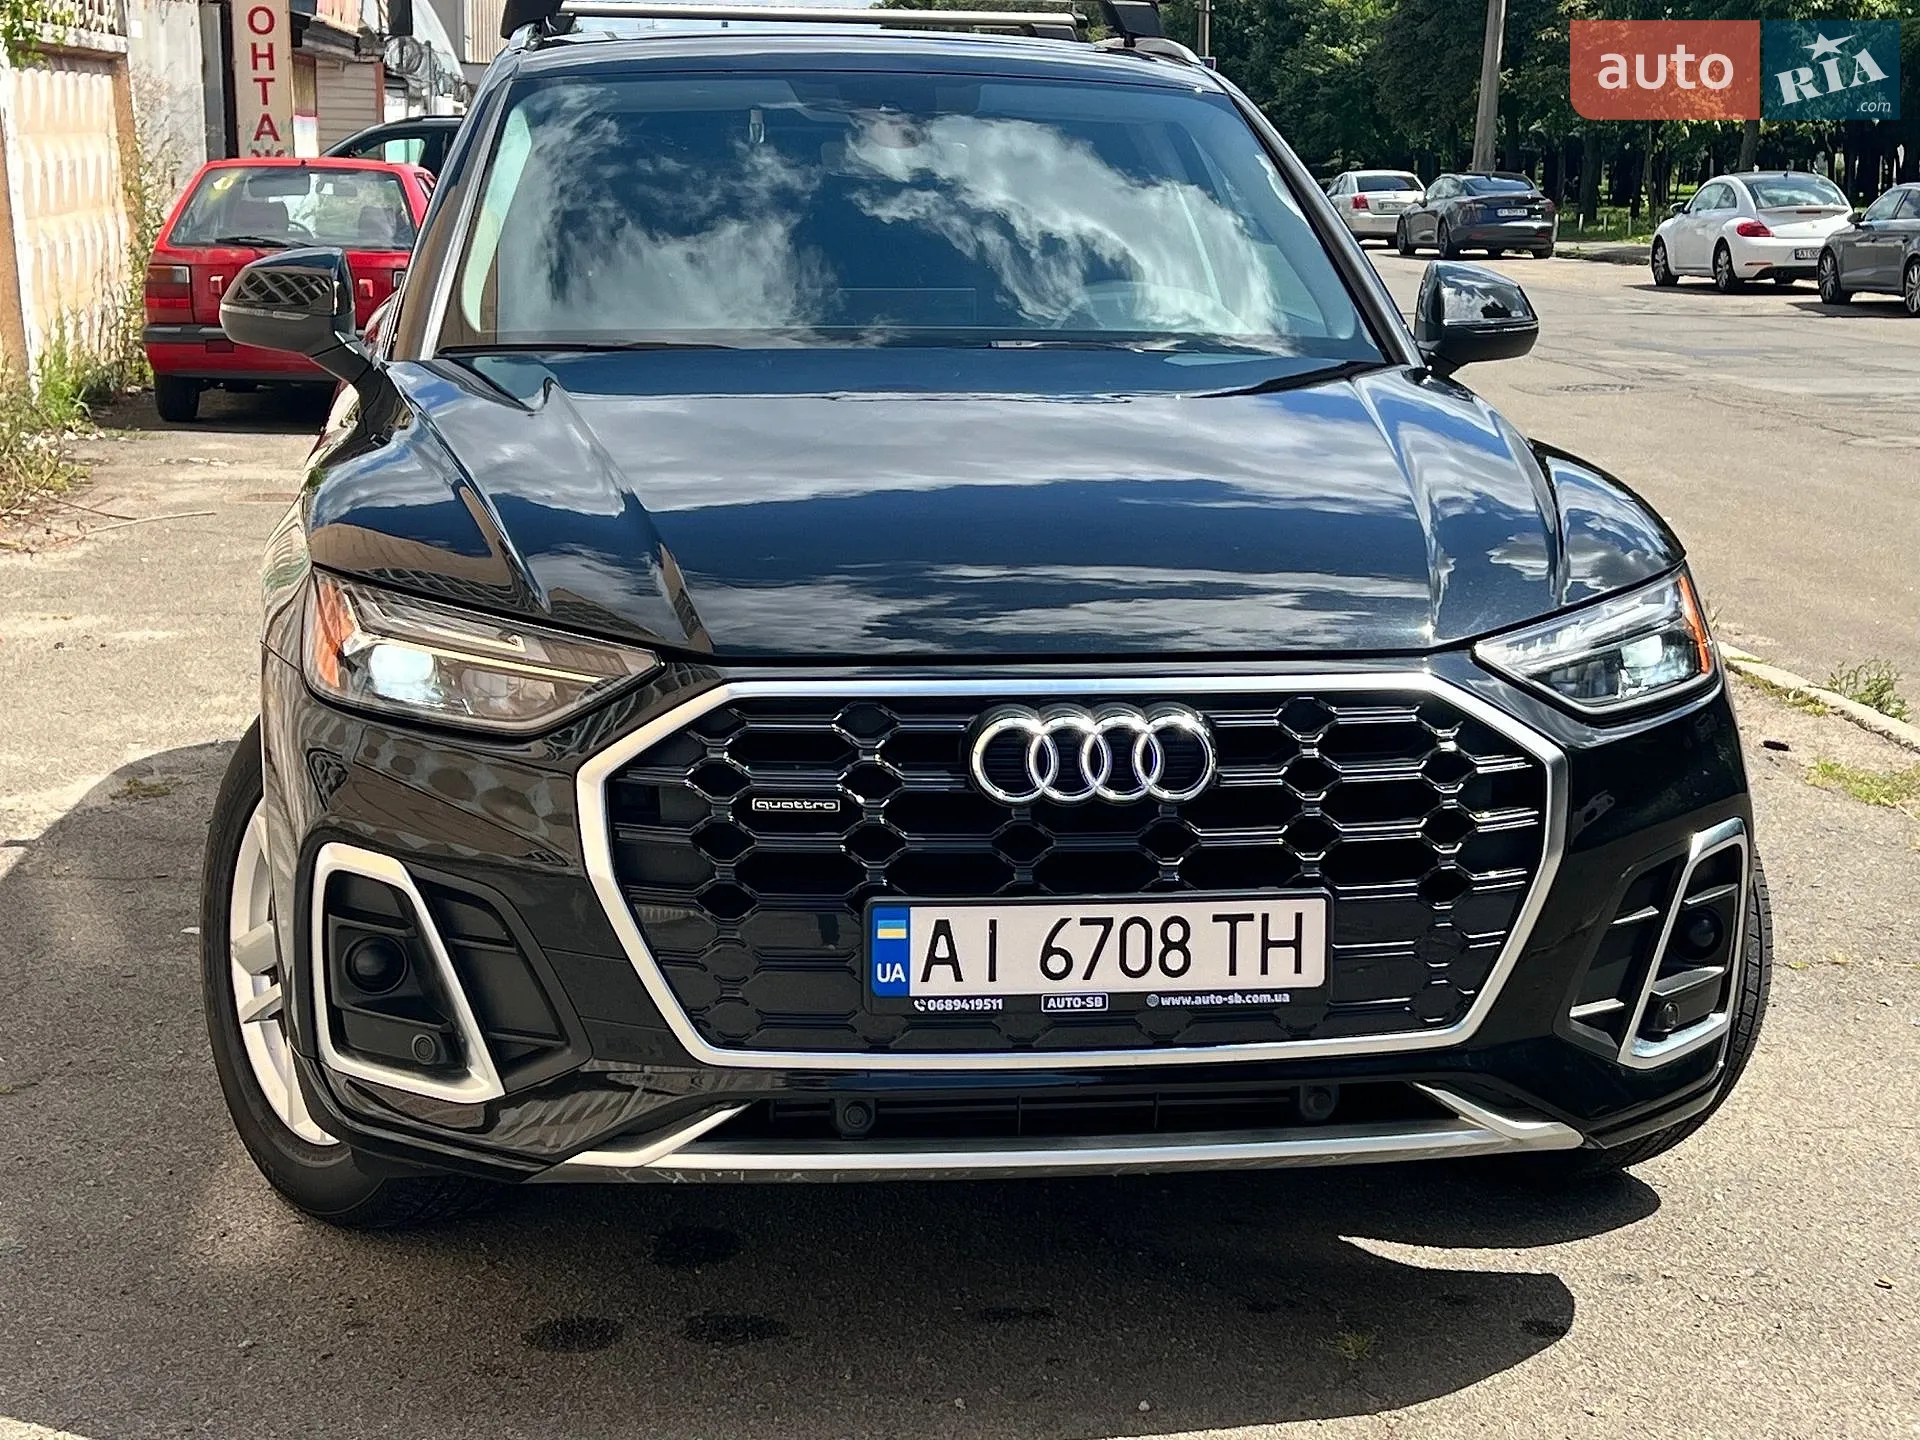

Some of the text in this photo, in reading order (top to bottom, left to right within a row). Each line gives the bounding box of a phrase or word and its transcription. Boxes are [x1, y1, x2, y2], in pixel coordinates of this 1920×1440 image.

[756, 801, 836, 810] quattro
[1039, 914, 1191, 981] 6708
[1211, 911, 1303, 977] TH
[876, 962, 906, 983] UA
[927, 998, 1003, 1012] 0689419511
[1047, 996, 1103, 1009] AUTO-SB
[1160, 992, 1290, 1007] www.auto-sb.com.ua
